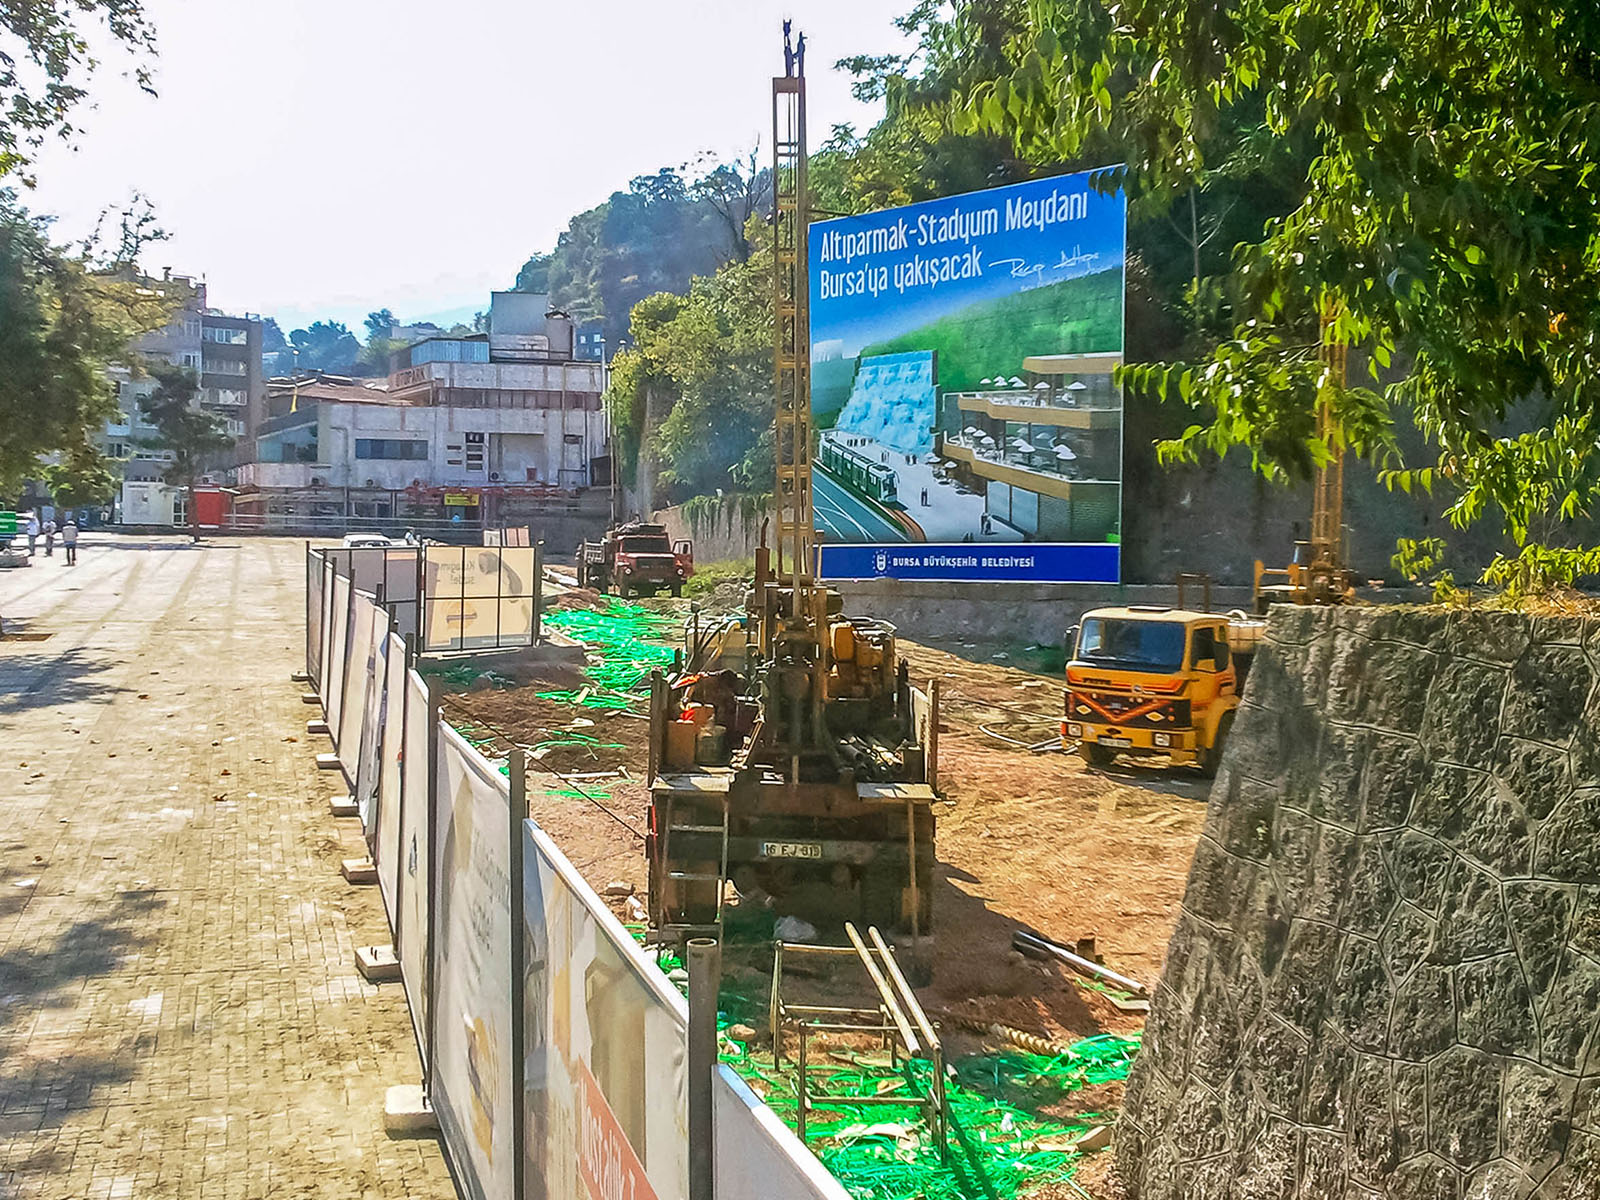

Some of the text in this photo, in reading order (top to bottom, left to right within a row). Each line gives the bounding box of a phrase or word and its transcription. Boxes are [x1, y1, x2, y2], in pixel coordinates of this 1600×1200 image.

[821, 189, 1088, 264] Altıparmak-Stadyum Meydanı
[820, 263, 888, 300] Bursa'ya
[894, 245, 983, 294] yakışacak
[892, 555, 1035, 569] BURSA BÜYÜKŞEHİR BELEDİYESİ
